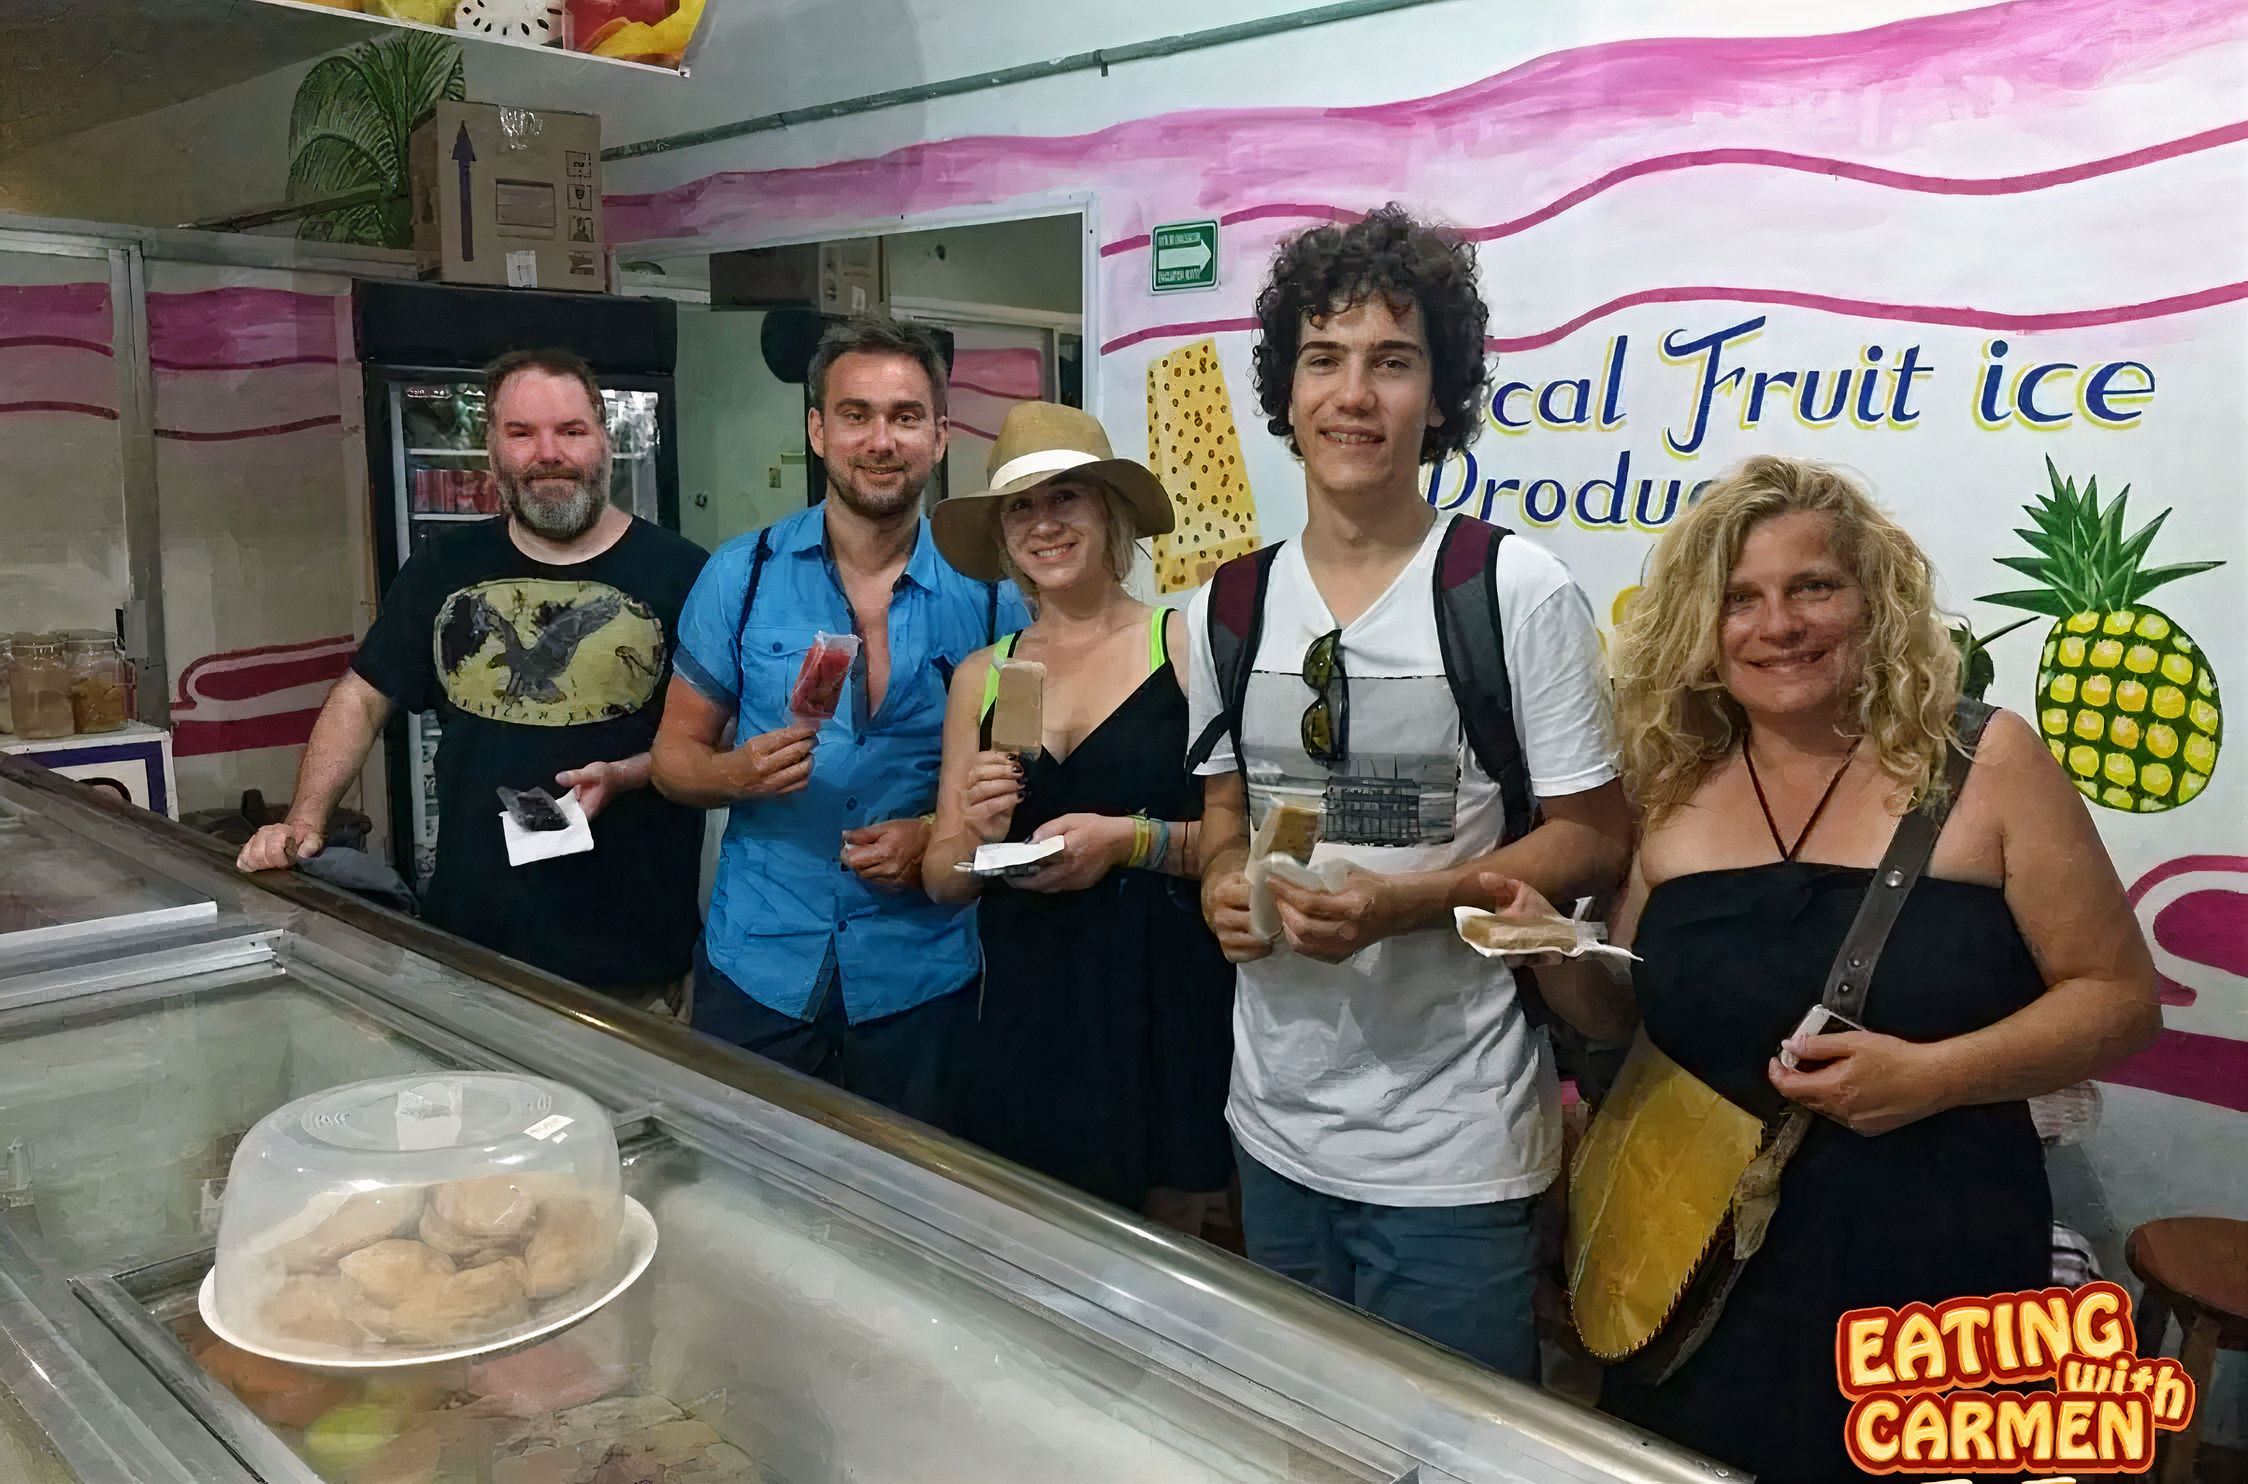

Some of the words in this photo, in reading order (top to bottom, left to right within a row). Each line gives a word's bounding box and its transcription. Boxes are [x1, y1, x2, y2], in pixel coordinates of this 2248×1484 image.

[1487, 334, 1628, 434] cal
[1659, 314, 1934, 460] Fruit
[1975, 338, 2157, 431] ice
